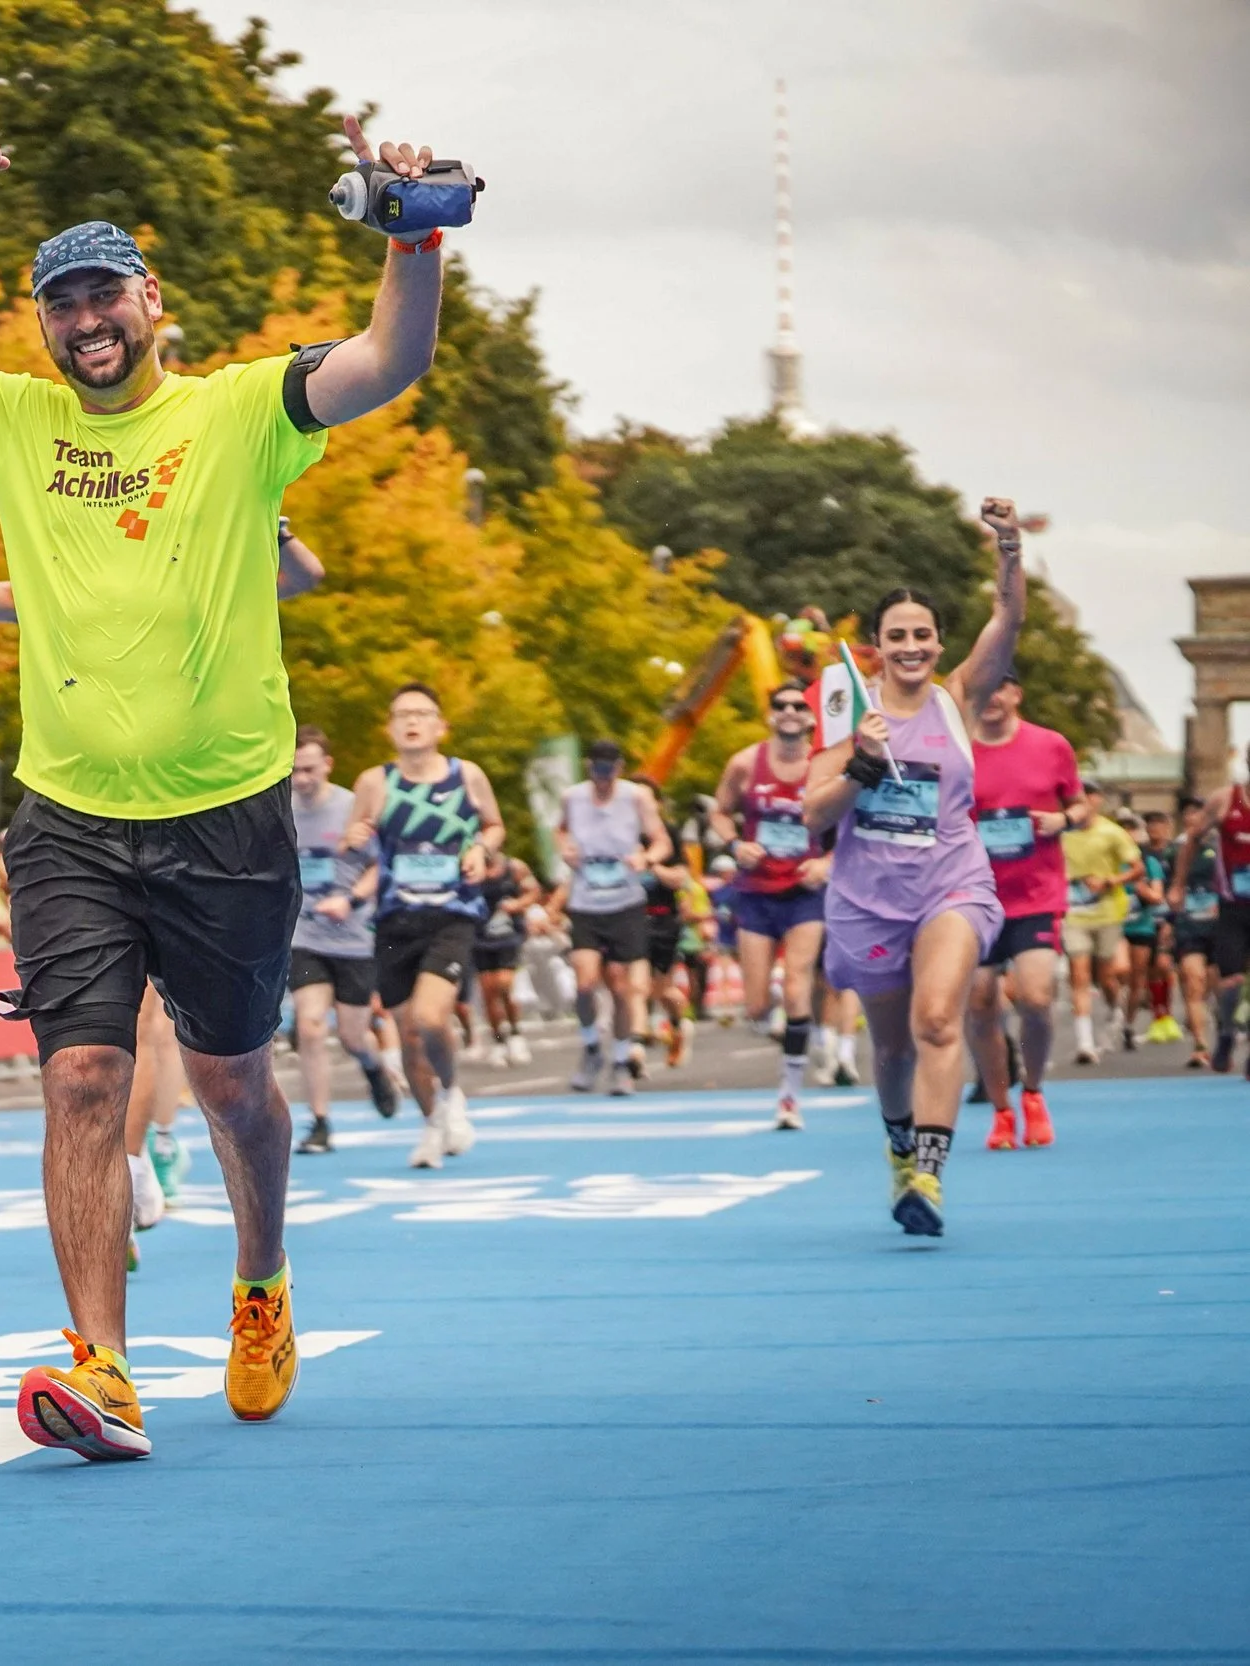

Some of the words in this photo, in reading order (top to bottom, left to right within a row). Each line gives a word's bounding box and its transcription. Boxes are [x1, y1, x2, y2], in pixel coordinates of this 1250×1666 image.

[54, 438, 114, 468] Team
[46, 467, 150, 500] Achilles
[82, 489, 150, 508] INTERNATIONAL
